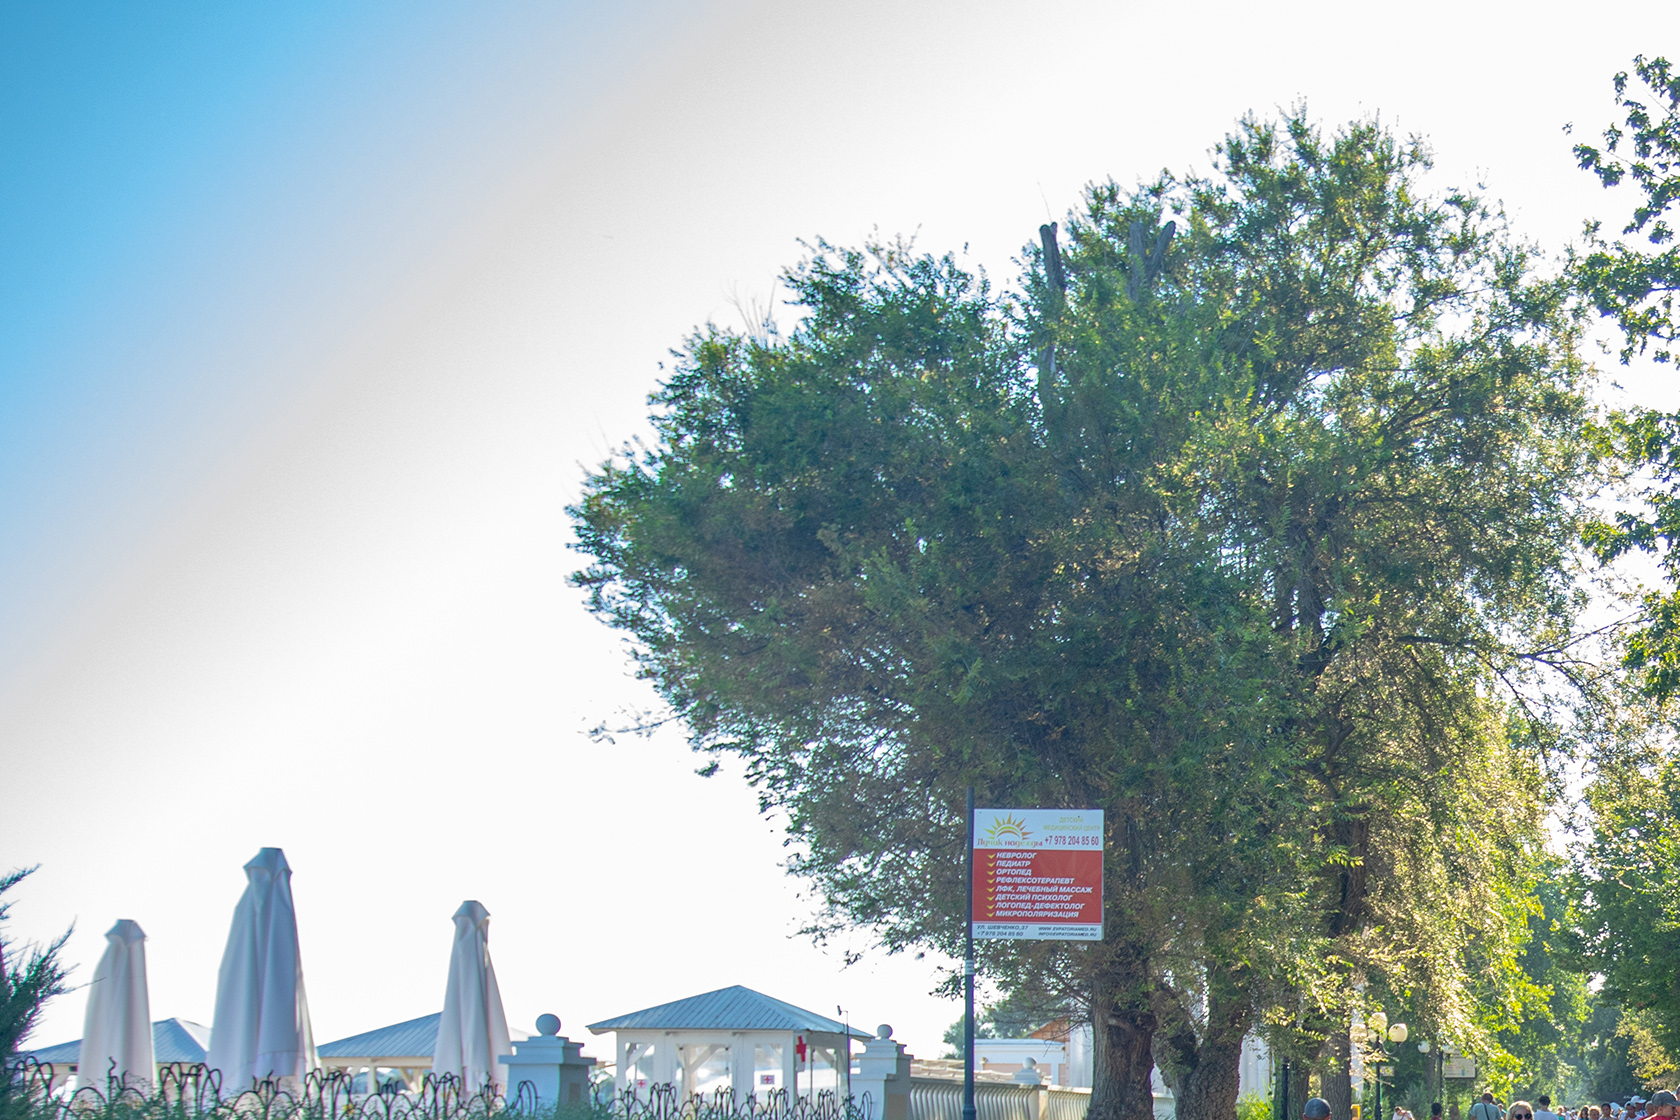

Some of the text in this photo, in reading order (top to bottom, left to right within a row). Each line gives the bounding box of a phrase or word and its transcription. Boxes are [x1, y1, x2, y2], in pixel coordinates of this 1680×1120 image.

[1044, 835, 1099, 846] +7 978 204 85 60
[996, 860, 1031, 868] ПЕДИАТР
[996, 868, 1032, 876] ОРТОПЕД
[995, 885, 1015, 893] ЛФК,
[995, 893, 1031, 901] ДЕТСКИЙ
[995, 902, 1085, 910] ЛОГОПЕД-ДЕФЕКТОЛОГ
[995, 910, 1080, 918] МИКРОПОЛЯРИЗАЦИЯ
